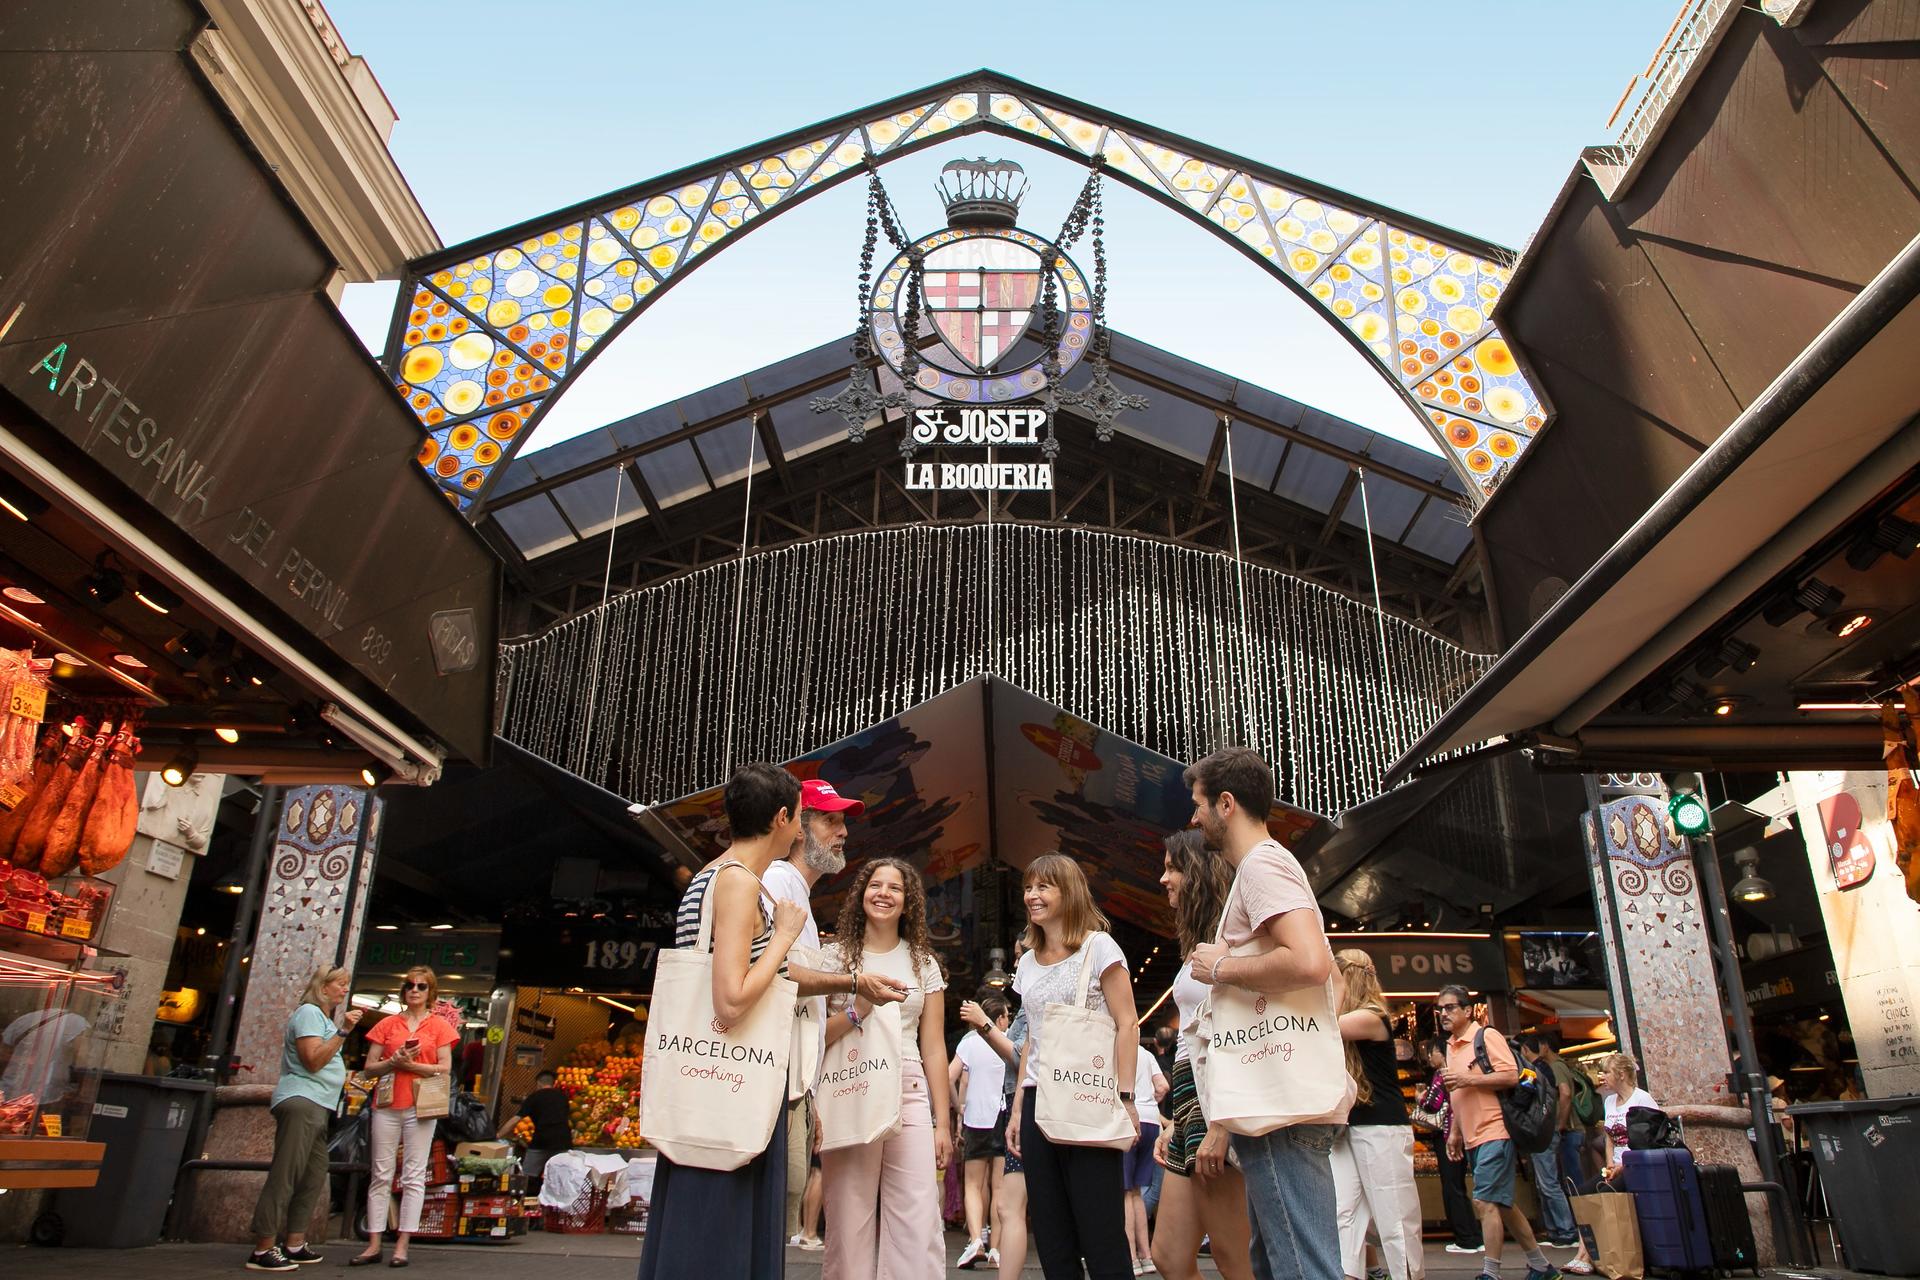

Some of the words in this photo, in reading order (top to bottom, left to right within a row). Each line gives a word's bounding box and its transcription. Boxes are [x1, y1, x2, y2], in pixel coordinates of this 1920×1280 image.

[943, 409, 1047, 443] JOSEP
[905, 463, 935, 490] LA
[941, 463, 1053, 490] BOQUERIA
[29, 342, 215, 516] ARTESANIA
[227, 506, 276, 568] DEL
[275, 547, 344, 632] PERNIL
[360, 626, 393, 665] 889
[583, 939, 657, 970] 1897
[1390, 953, 1475, 975] PONS
[1886, 1006, 1910, 1020] CHOICE
[1213, 1015, 1320, 1049] BARCELONA
[658, 1034, 775, 1067] BARCELONA
[1241, 1042, 1295, 1065] cooking
[681, 1064, 745, 1093] cooking
[832, 1080, 870, 1098] cooking
